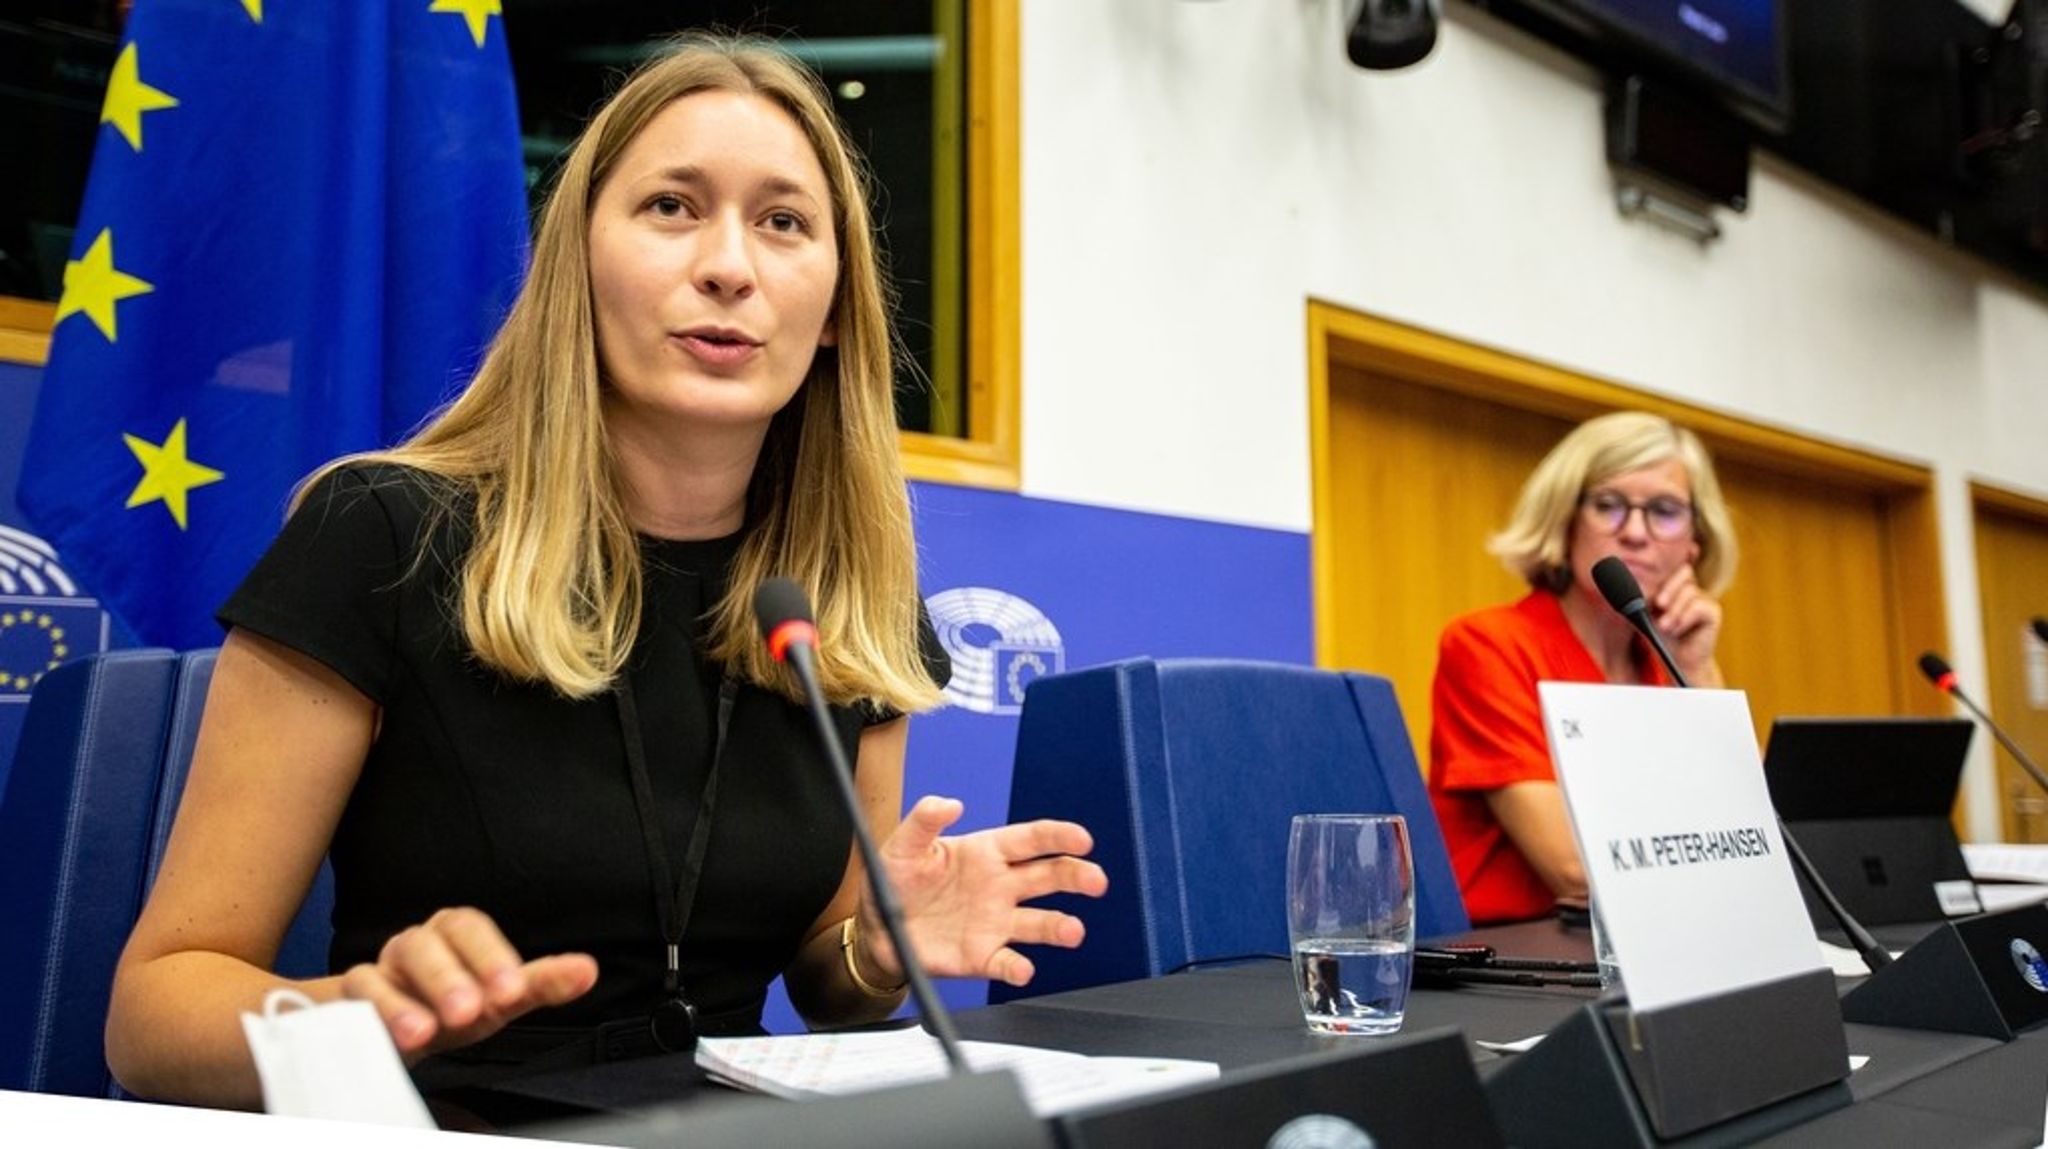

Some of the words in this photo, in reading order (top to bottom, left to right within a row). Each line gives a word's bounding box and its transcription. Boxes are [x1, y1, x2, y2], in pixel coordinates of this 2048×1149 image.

[1562, 718, 1584, 738] DK
[1609, 839, 1631, 870] K.
[1629, 837, 1653, 868] M.
[1651, 828, 1770, 866] PETER-HANSEN
